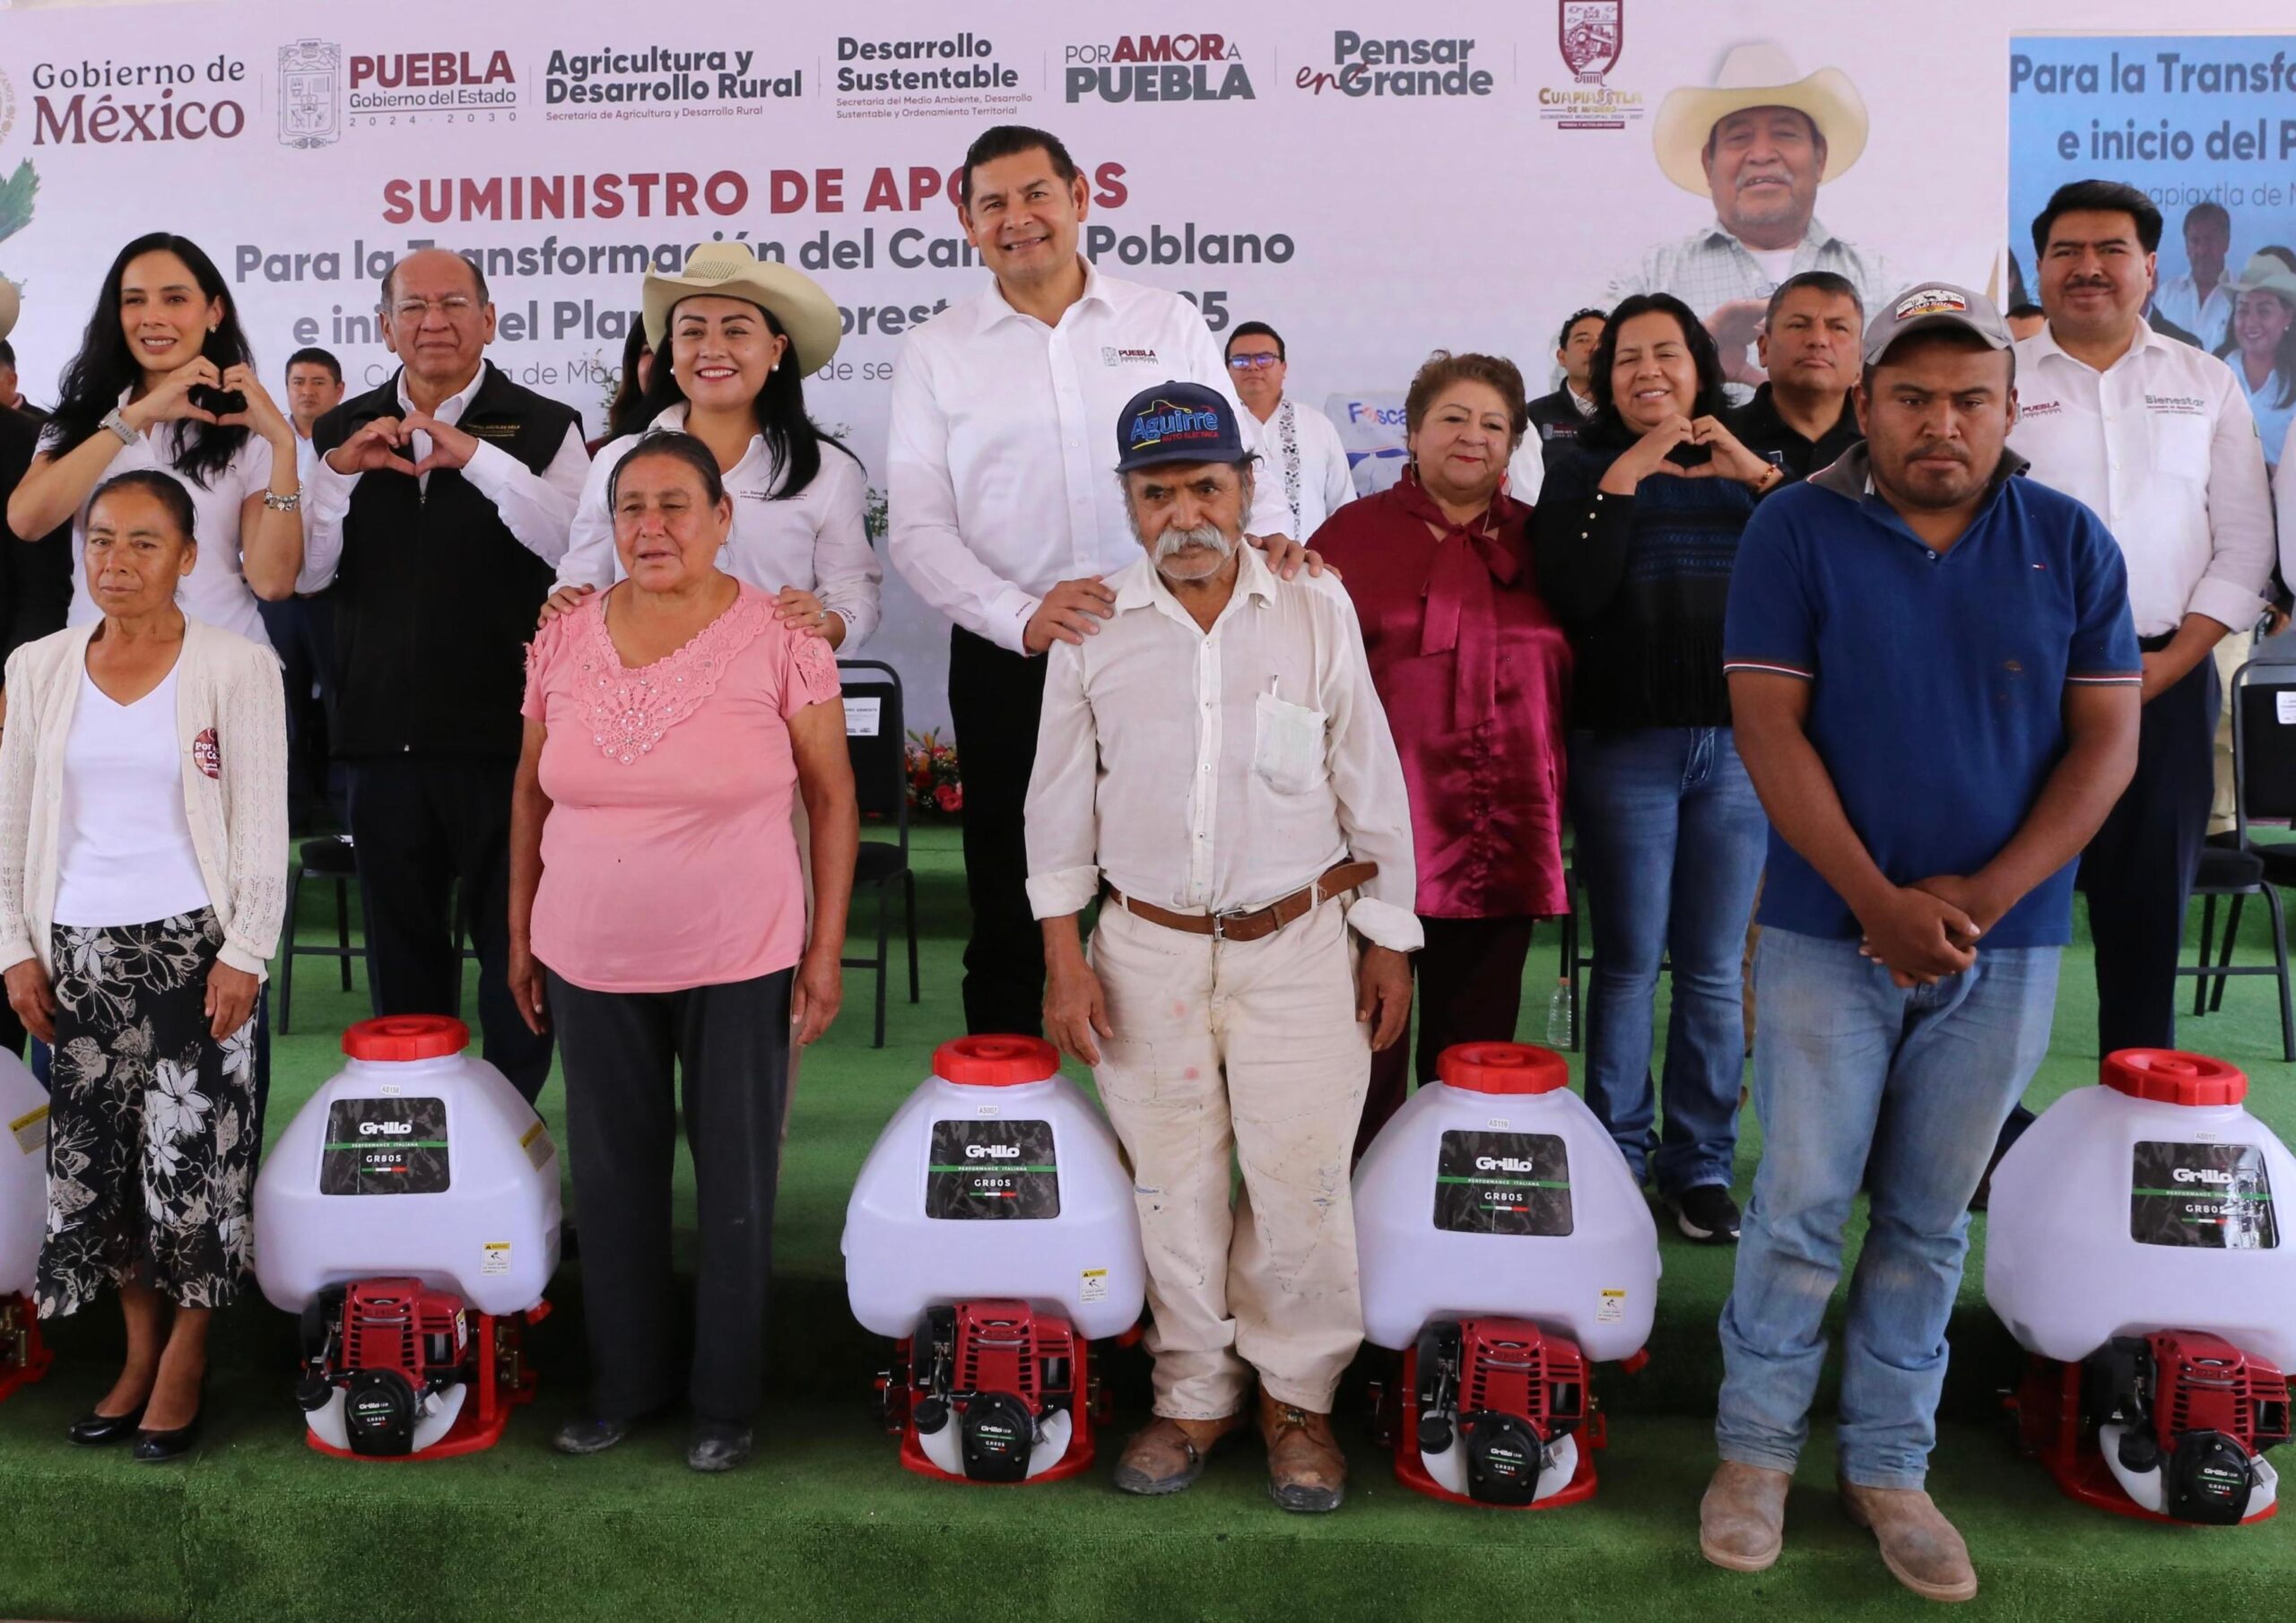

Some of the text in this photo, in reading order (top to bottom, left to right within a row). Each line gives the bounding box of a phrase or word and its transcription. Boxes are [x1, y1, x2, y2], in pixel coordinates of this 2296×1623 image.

[837, 32, 992, 62] Desarrollo
[1065, 34, 1242, 64] POR AMOR A
[1334, 30, 1475, 66] Pensar
[32, 59, 196, 90] Gobierno
[205, 55, 245, 82] de
[350, 50, 516, 90] PUEBLA
[545, 47, 754, 82] Agricultura y
[837, 63, 1019, 91] Sustentable
[2010, 54, 2099, 94] Para
[2111, 52, 2145, 93] la
[545, 71, 803, 105] Desarrollo Rural
[1065, 64, 1257, 103] PUEBLA
[1338, 62, 1494, 98] Grande
[350, 88, 517, 108] Gobierno del Estado
[887, 95, 901, 106] del
[904, 95, 932, 105] Medio
[985, 93, 1033, 103] Desarrollo
[32, 89, 245, 146] México
[600, 108, 613, 119] de
[615, 108, 672, 121] Agricultura
[673, 109, 679, 119] y
[682, 107, 735, 117] Desarrollo
[736, 105, 763, 116] Rural
[836, 108, 892, 119] Sustentable
[902, 108, 970, 117] Ordenamiento
[971, 107, 1017, 117] Territorial
[2057, 130, 2080, 161] e
[2091, 118, 2194, 161] inicio
[2205, 118, 2266, 161] del
[382, 169, 749, 224] SUMINISTRO
[770, 169, 844, 214] DE
[2251, 181, 2283, 206] de
[236, 243, 340, 282] Para
[354, 239, 395, 280] la
[799, 227, 874, 270] del
[1086, 222, 1295, 266] Poblano
[292, 317, 320, 346] e
[492, 299, 539, 342] el
[1118, 349, 1156, 357] PUEBLA
[523, 361, 558, 385] de
[2022, 401, 2060, 413] PUEBLA
[1130, 410, 1219, 442] Aguirre
[359, 1121, 413, 1135] Grillo
[366, 1154, 402, 1163] GR80S
[965, 1144, 1021, 1159] Grillo
[1475, 1157, 1533, 1173] Grillo
[974, 1178, 1012, 1187] GR80S
[2172, 1167, 2234, 1184] Grillo
[1484, 1192, 1523, 1202] GR80S
